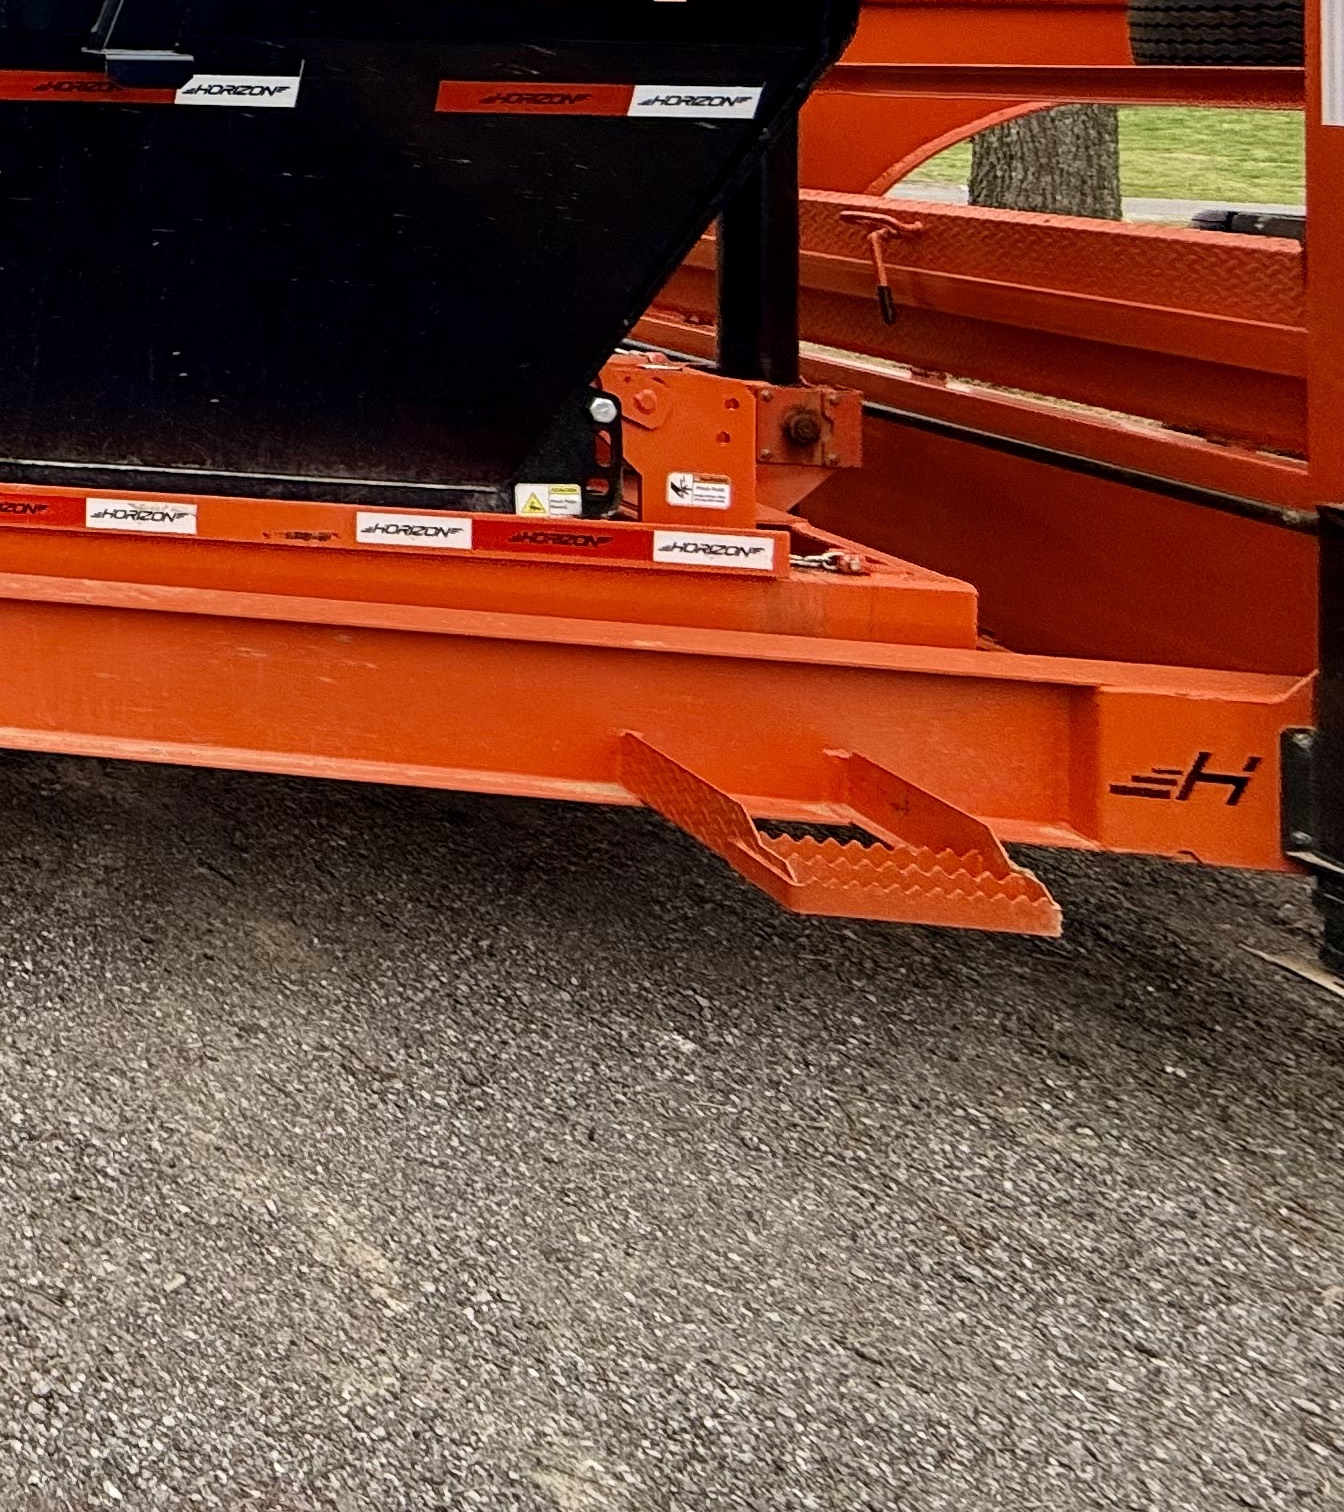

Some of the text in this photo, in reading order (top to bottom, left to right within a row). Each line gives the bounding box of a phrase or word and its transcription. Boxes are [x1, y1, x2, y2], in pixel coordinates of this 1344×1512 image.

[192, 83, 279, 97] HORIZON
[493, 92, 580, 105] HORIZON
[650, 95, 739, 107] HORIZON
[99, 506, 177, 525] HORIZON
[373, 522, 452, 538] HORIZON
[520, 531, 601, 547] HORIZON
[671, 543, 755, 558] HORIZON
[1175, 751, 1262, 807] H
